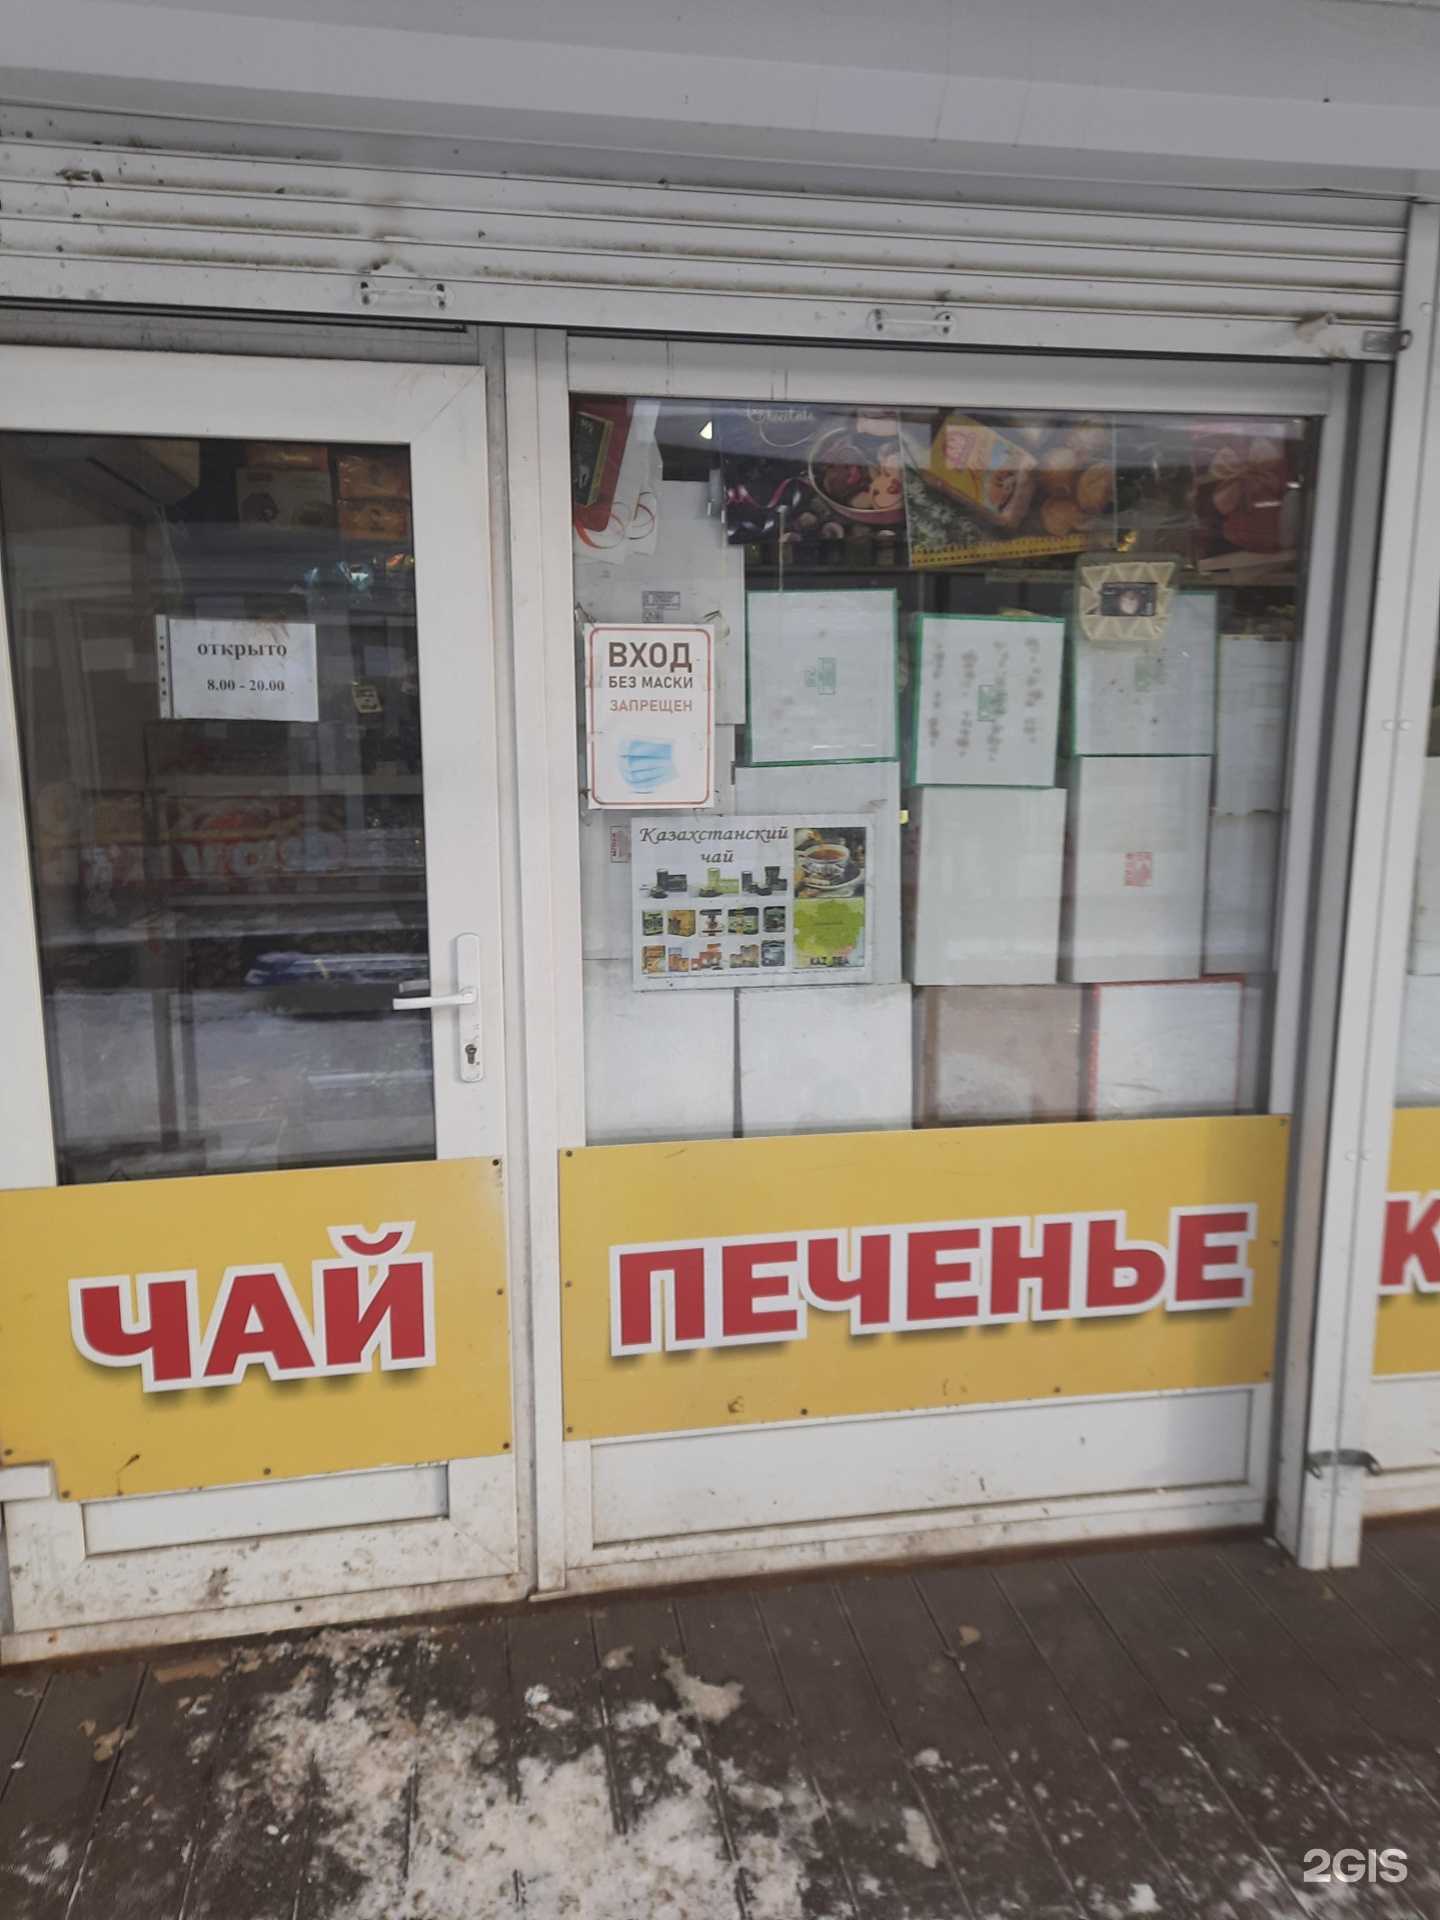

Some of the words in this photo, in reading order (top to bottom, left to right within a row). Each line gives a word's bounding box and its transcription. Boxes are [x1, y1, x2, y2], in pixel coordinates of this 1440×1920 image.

[197, 643, 288, 660] открыто
[608, 642, 693, 673] ВХОД
[207, 679, 235, 691] 8.00
[249, 679, 285, 691] 20.00
[608, 675, 637, 689] БЕЗ
[641, 676, 694, 689] МАСКИ
[609, 699, 693, 714] ЗАПРЕЩЕН
[639, 826, 789, 844] Казахстанский
[700, 849, 734, 863] чай
[611, 1204, 1257, 1356] ПЕЧЕНЬЕ
[69, 1222, 435, 1392] ЧАЙ
